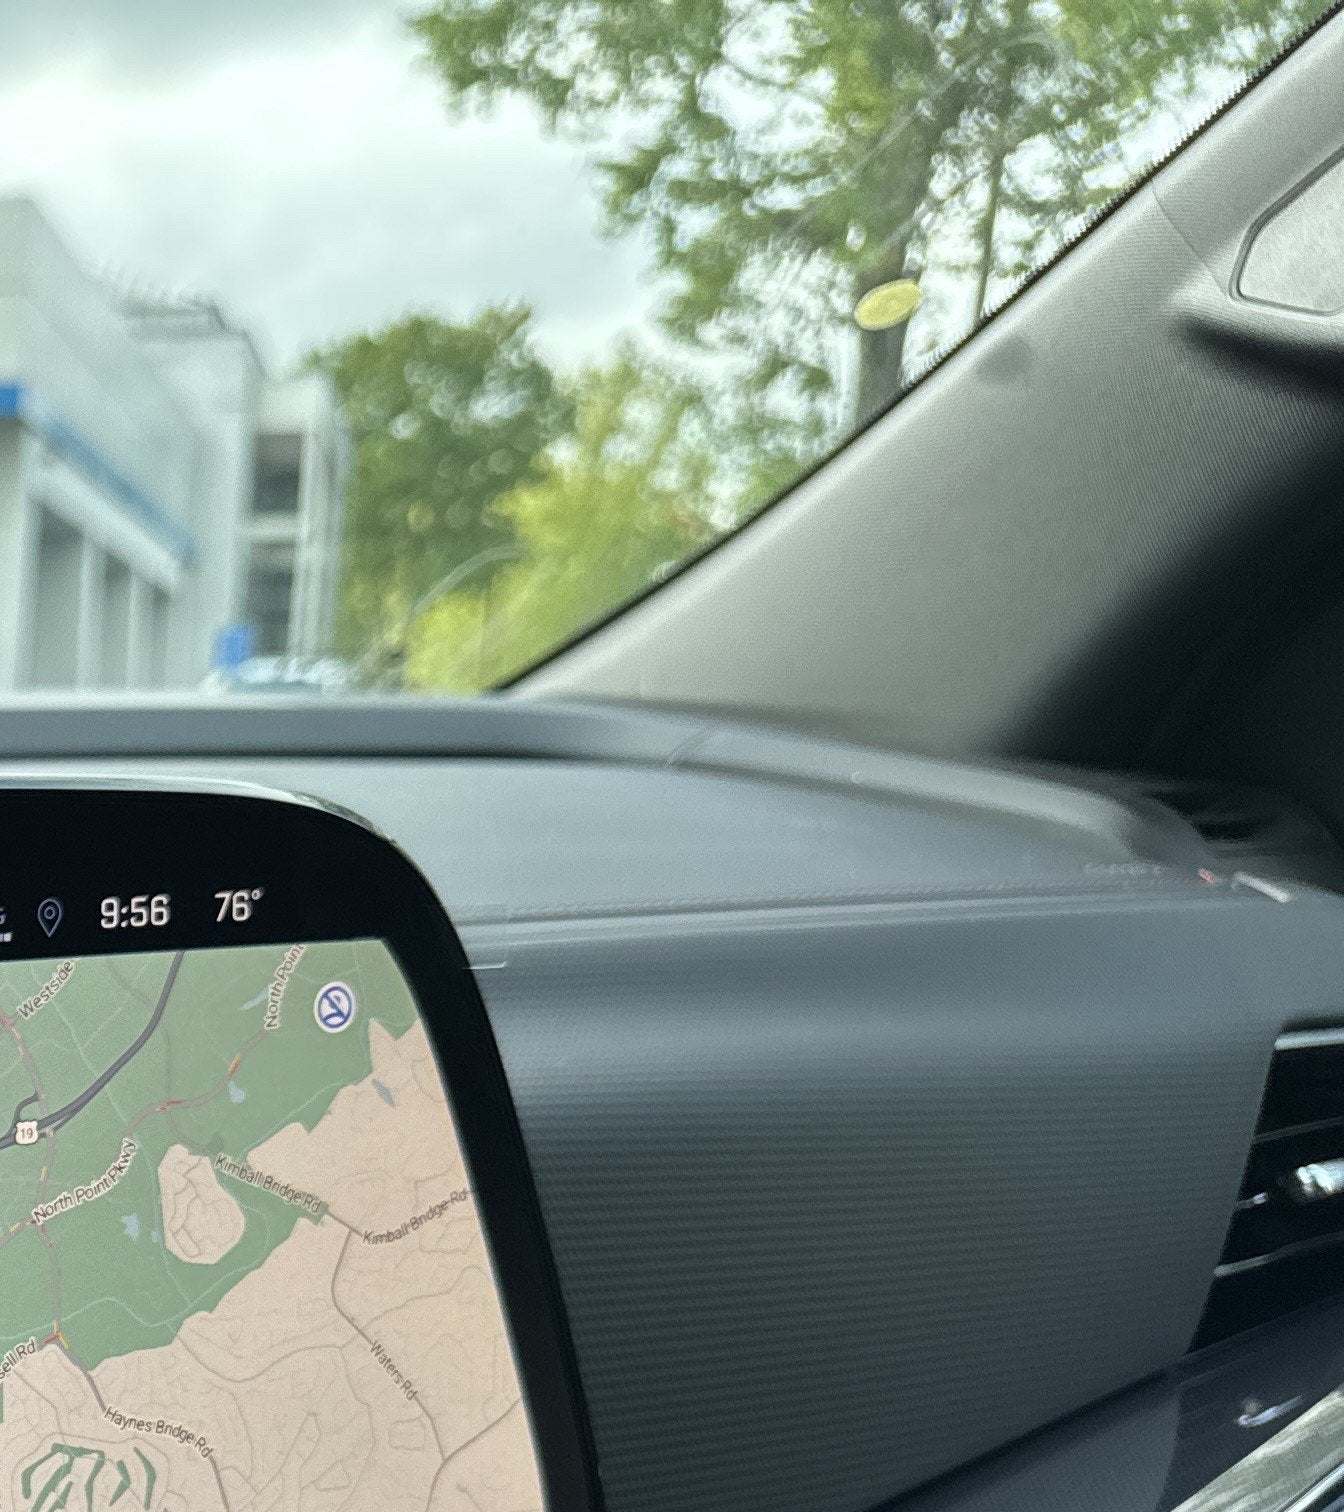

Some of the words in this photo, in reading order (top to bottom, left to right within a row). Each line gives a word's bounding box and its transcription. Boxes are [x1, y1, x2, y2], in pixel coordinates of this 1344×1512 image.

[100, 895, 170, 929] 9:56
[18, 961, 73, 1017] Westside
[266, 982, 284, 1028] North
[32, 1196, 73, 1223] North
[74, 1176, 110, 1206] Point
[108, 1138, 137, 1184] Pkwy
[215, 1155, 263, 1186] Kimball
[263, 1175, 306, 1205] Bridge
[304, 1193, 322, 1213] Rd
[363, 1222, 408, 1245] Kimball
[410, 1200, 448, 1230] Bridge
[449, 1188, 468, 1203] Rd
[14, 1340, 37, 1364] Rd
[369, 1340, 404, 1385] Waters
[402, 1381, 418, 1401] Rd
[103, 1407, 154, 1433] Haynes
[155, 1420, 194, 1446] Bridge
[193, 1436, 213, 1458] Rd
